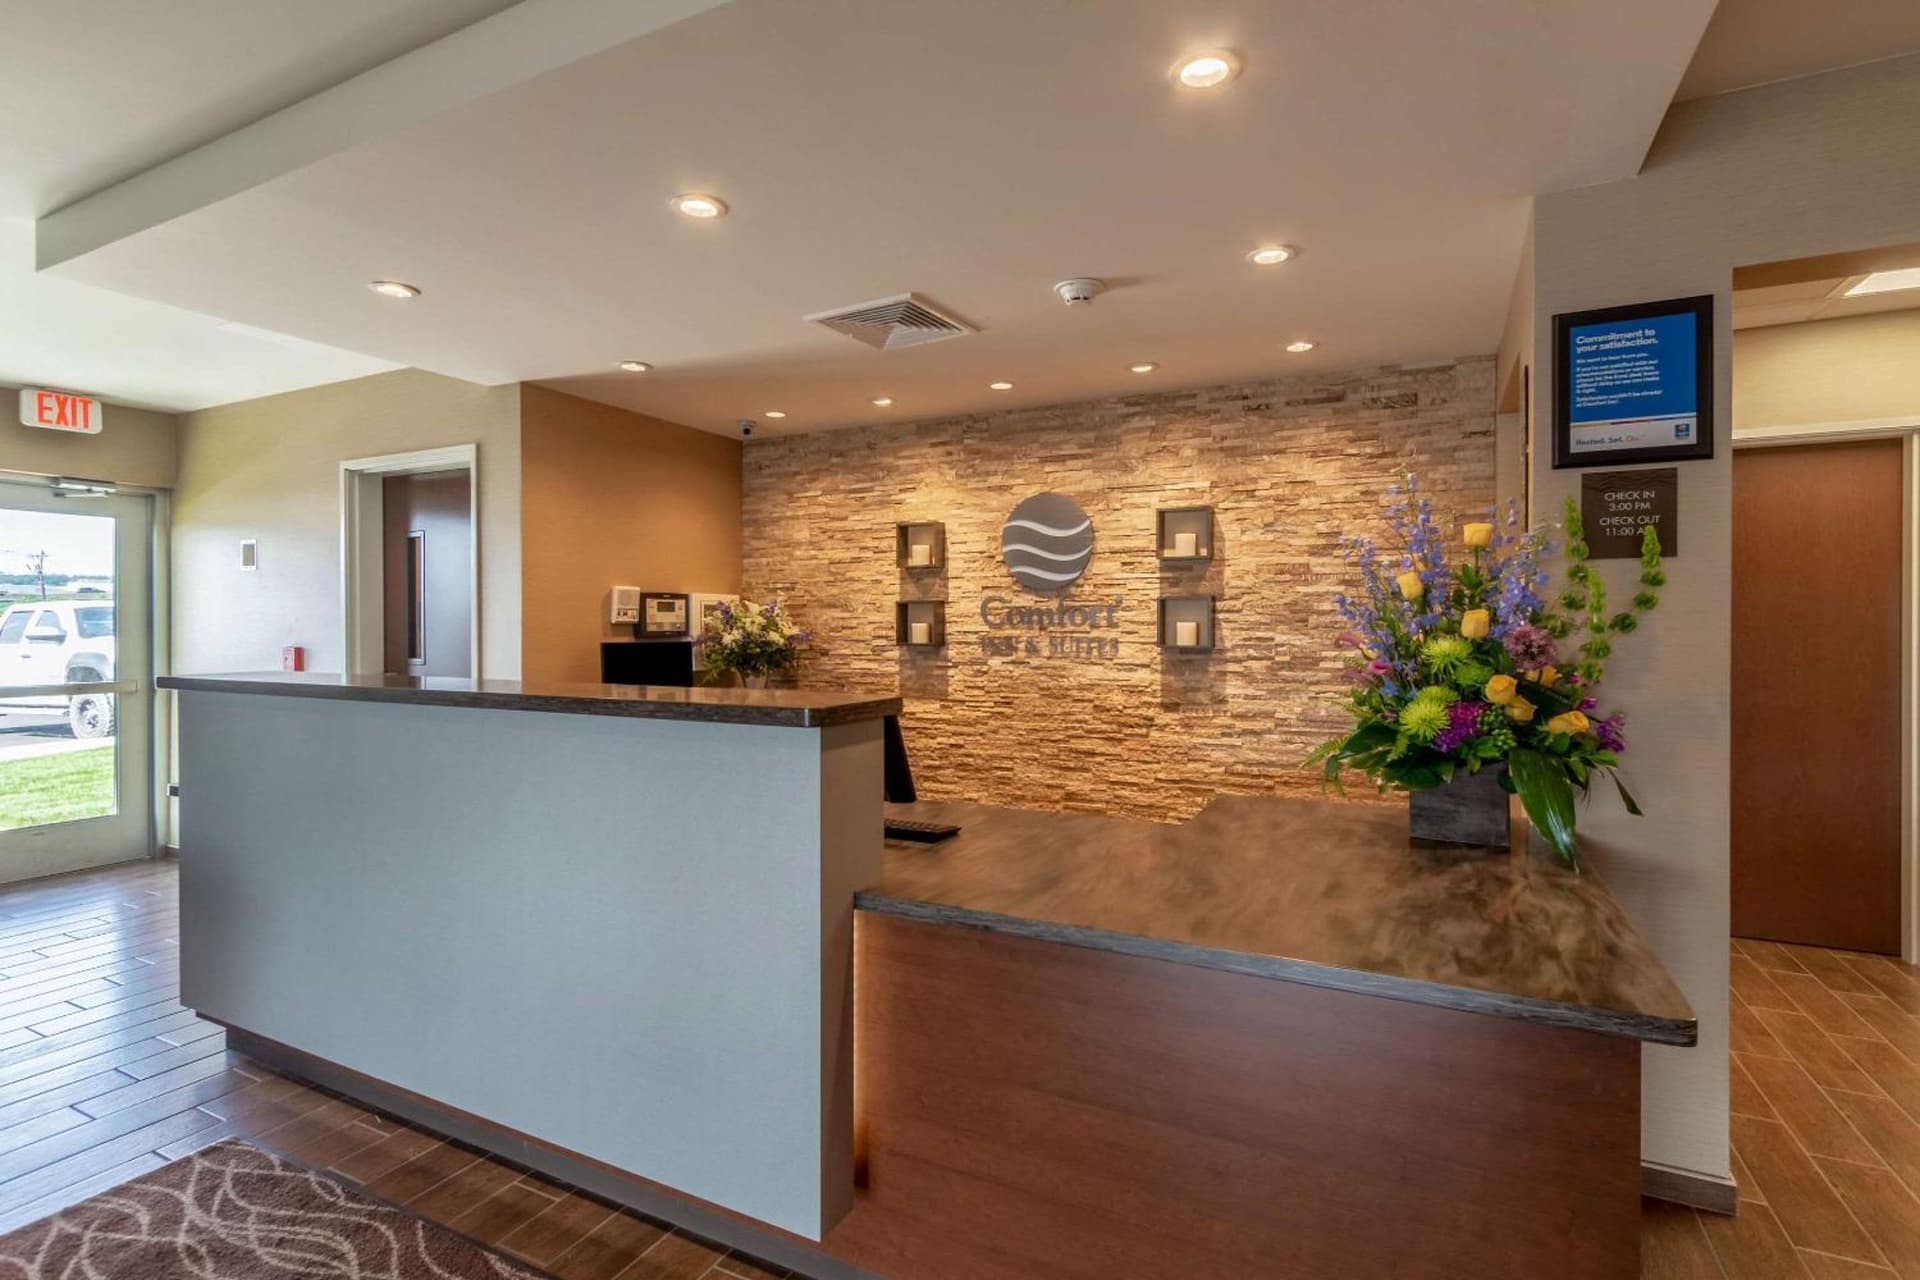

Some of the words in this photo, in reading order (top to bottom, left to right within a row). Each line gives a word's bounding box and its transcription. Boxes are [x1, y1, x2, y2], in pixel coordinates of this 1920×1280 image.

[1576, 331, 1643, 344] Commitment
[1645, 328, 1656, 337] to
[1576, 344, 1599, 353] your
[1600, 337, 1659, 350] satisfaction.
[36, 391, 93, 430] EXIT
[1604, 491, 1639, 501] CHECK
[1643, 490, 1655, 499] IN
[1609, 502, 1632, 511] 3:00
[1635, 501, 1651, 510] PM
[1600, 516, 1635, 526] CHECK
[1637, 515, 1661, 525] OUT
[1606, 527, 1635, 536] 11:00
[981, 595, 1120, 630] Comfort
